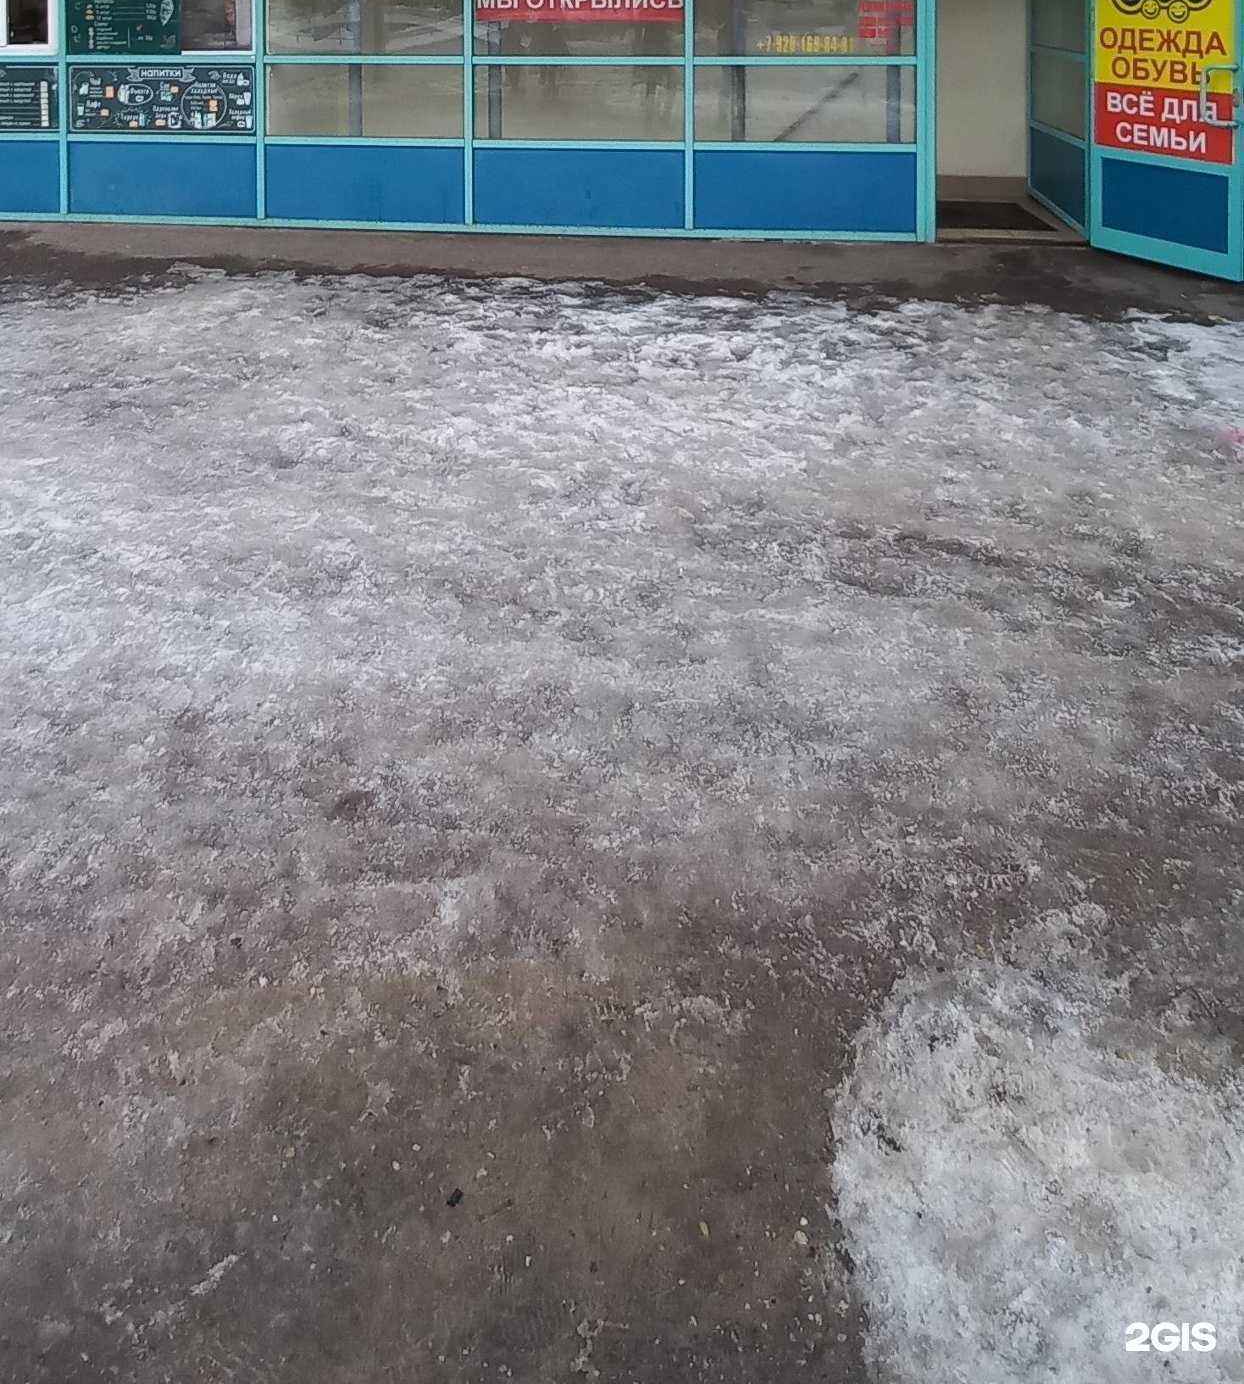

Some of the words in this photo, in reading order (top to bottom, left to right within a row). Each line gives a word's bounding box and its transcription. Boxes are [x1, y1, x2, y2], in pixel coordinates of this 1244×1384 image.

[1100, 27, 1227, 59] ОДЕЖДА
[1112, 57, 1210, 85] ОБУВЬ
[1106, 90, 1155, 117] ВСЁ
[1115, 122, 1206, 154] СЕМЬИ
